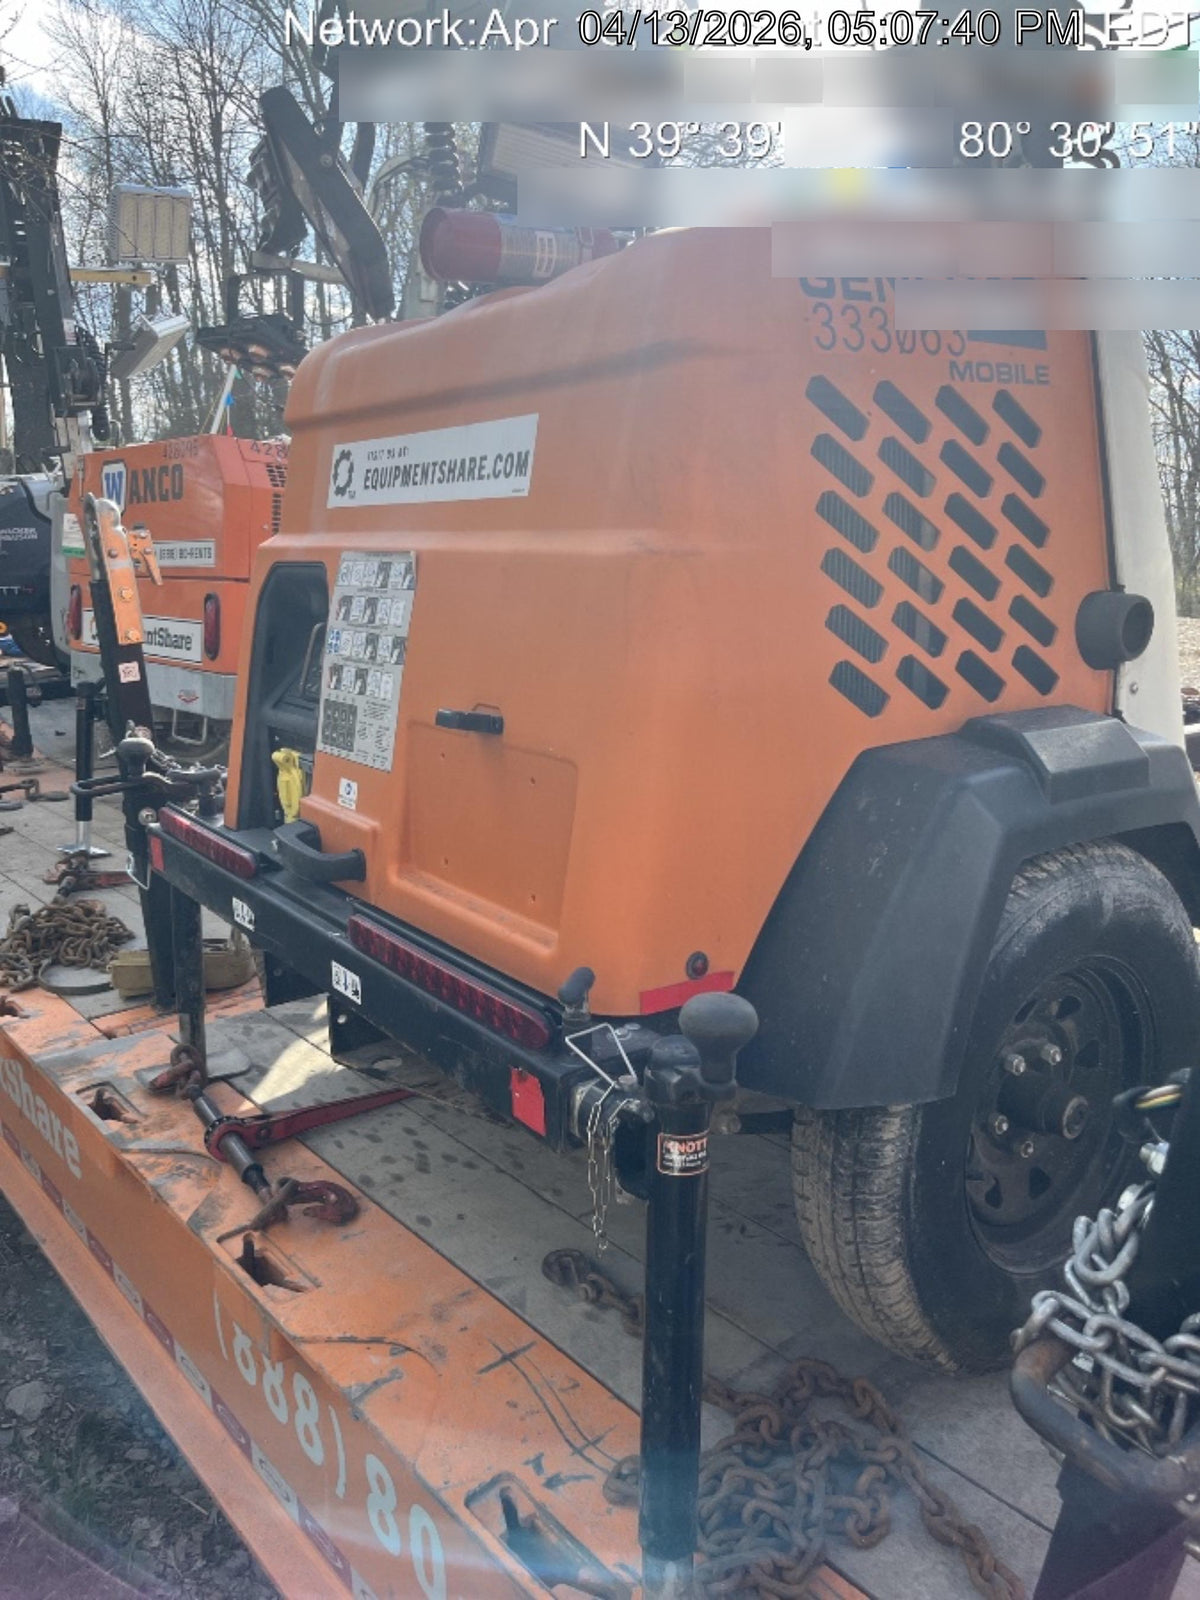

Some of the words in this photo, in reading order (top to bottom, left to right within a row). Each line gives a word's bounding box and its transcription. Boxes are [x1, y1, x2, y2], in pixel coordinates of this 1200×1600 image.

[949, 360, 1050, 386] MOBILE
[104, 463, 184, 506] WANCO
[363, 449, 530, 491] EQUIPMENTSHARE.COM
[144, 627, 193, 651] ntShare
